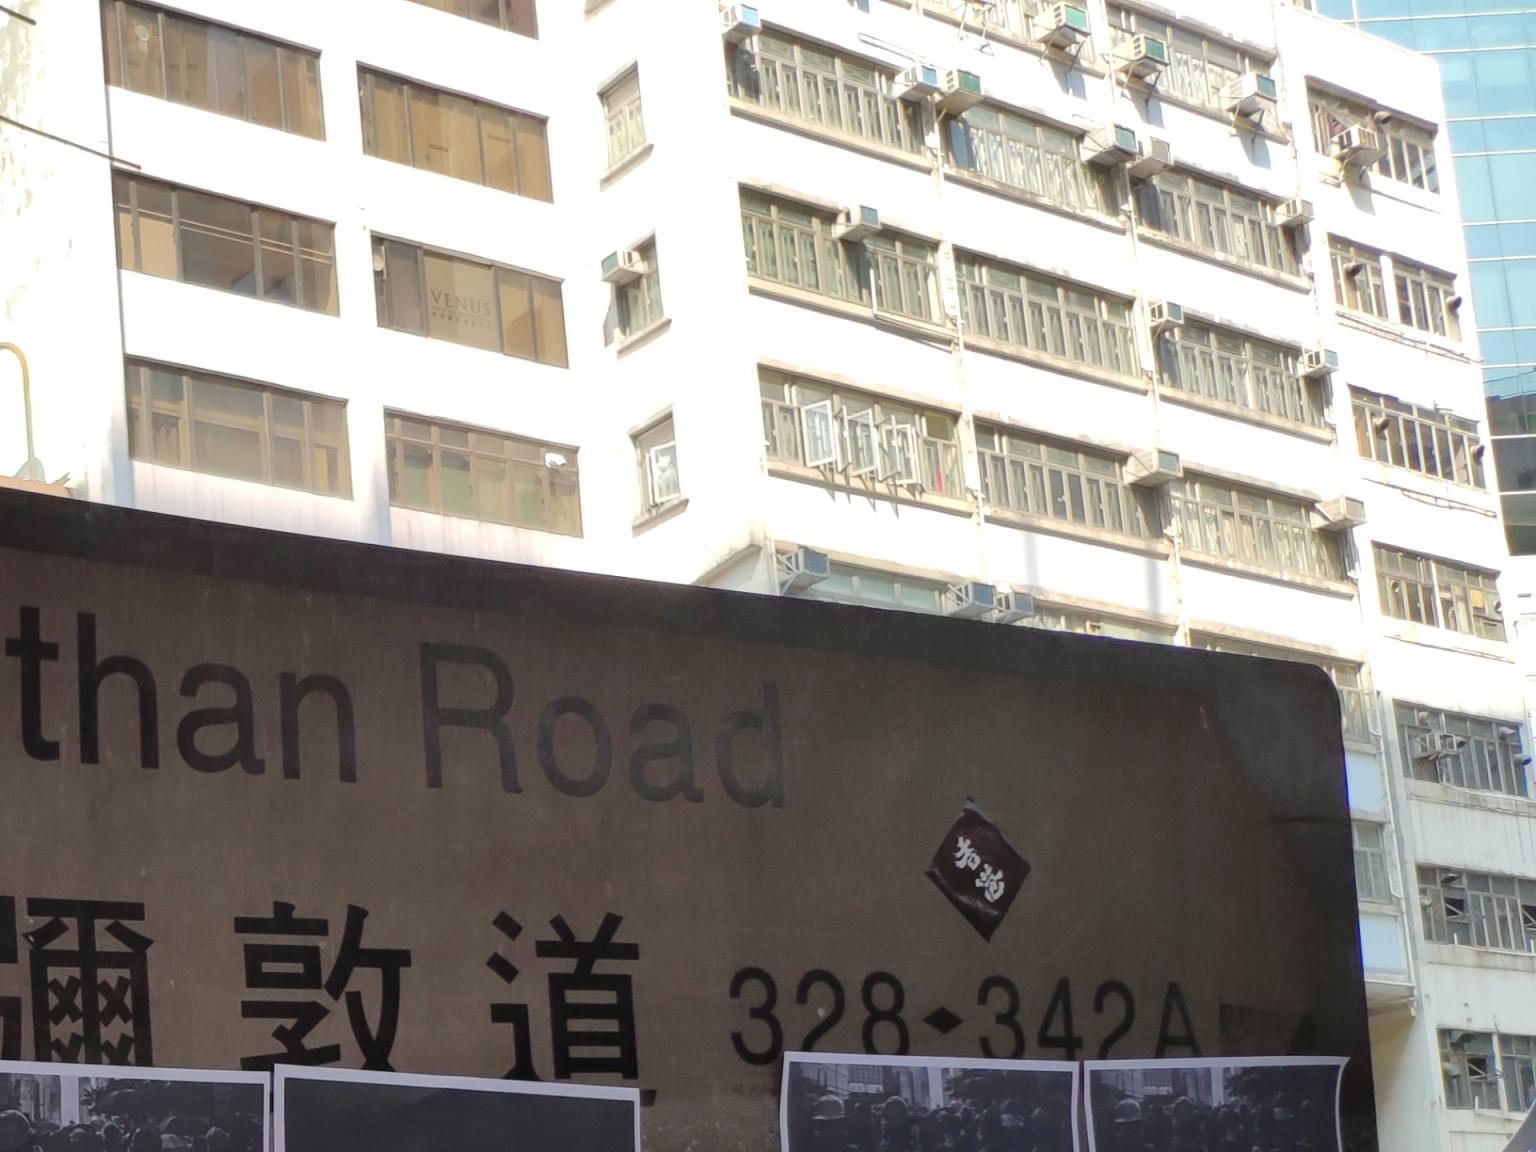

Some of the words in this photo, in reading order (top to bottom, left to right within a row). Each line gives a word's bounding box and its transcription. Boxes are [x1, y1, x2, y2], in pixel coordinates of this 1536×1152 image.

[430, 289, 491, 317] VENUS
[419, 640, 785, 808] Road
[730, 967, 910, 1066] 328
[977, 975, 1203, 1061] 342A
